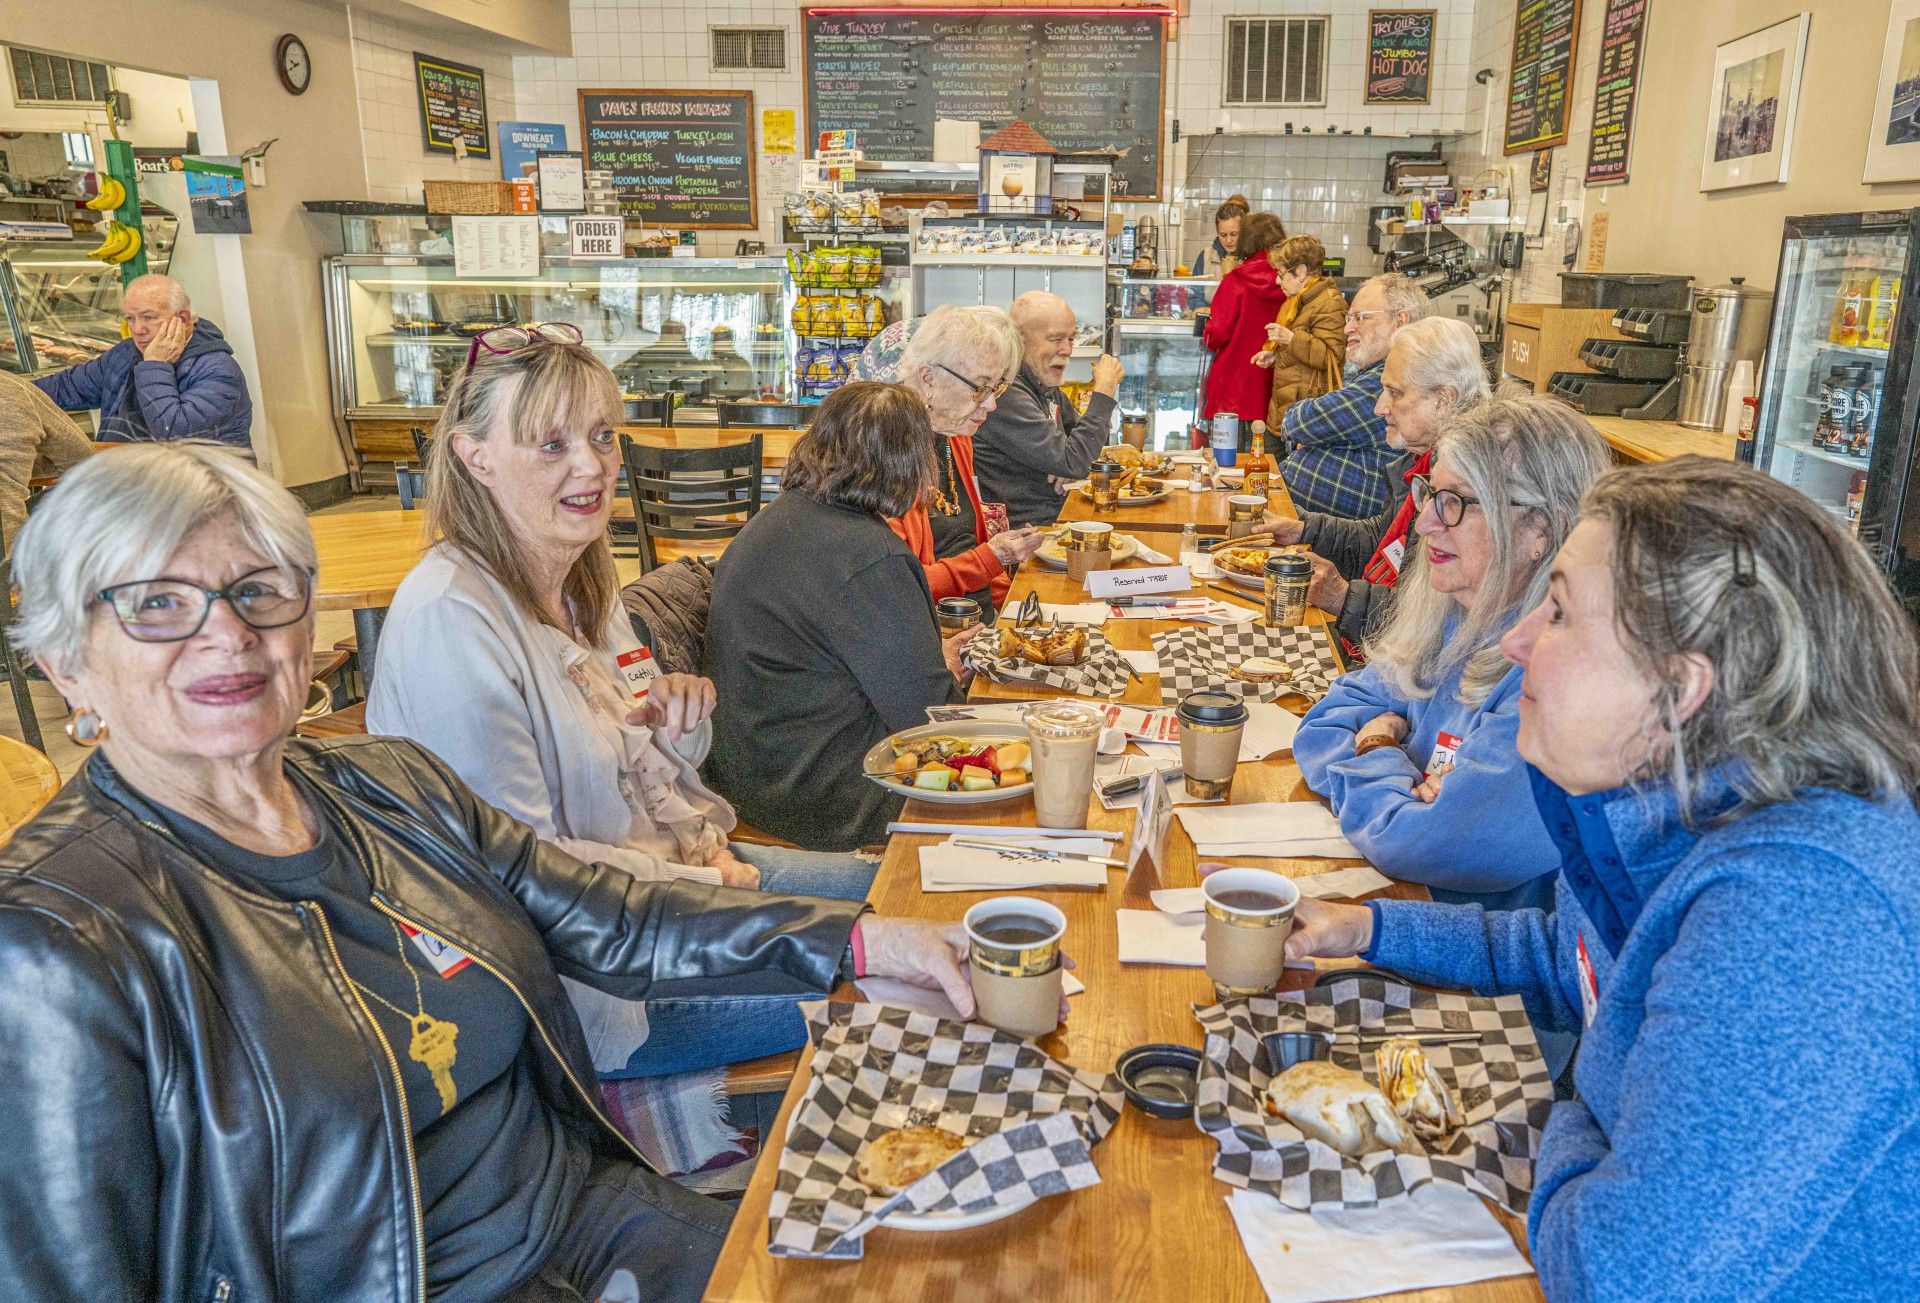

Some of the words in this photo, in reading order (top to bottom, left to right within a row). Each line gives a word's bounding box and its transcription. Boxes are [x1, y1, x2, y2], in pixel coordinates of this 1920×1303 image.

[819, 21, 840, 34] JIVE
[845, 21, 887, 34] TURKEY
[933, 22, 972, 34] CHICKEN
[977, 23, 1010, 34] CUTLET
[1044, 22, 1080, 35] SONYA
[1081, 22, 1127, 35] SPECIAL
[1372, 21, 1392, 36] TRY
[1394, 17, 1419, 32] OUR
[817, 42, 850, 52] STUFFED
[853, 42, 884, 52] TURKEY
[933, 42, 973, 52] CHICKEN
[975, 43, 1020, 52] PARMESAN
[1041, 43, 1093, 53] SOUTHERN
[1098, 43, 1119, 53] MAX
[1372, 38, 1396, 47] BLACK
[1402, 38, 1429, 47] ANGUS
[1381, 48, 1416, 57] JUMBO
[816, 61, 847, 71] DARTH
[849, 61, 881, 71] VADER
[932, 62, 977, 72] EGGPLANT
[979, 62, 1024, 72] PARMESAN
[1041, 62, 1090, 72] BULLSEYE
[1372, 58, 1400, 75] HOT
[1402, 58, 1428, 76] DOG
[816, 81, 833, 90] THE
[835, 81, 860, 90] CLUB
[932, 81, 976, 90] MEATBALL
[977, 81, 1016, 90] GRINDER
[1040, 81, 1071, 92] PHILLY
[1074, 81, 1109, 92] CHEESE
[641, 101, 683, 116] FAMOUS
[684, 102, 732, 117] BURGERS
[816, 101, 846, 109] TURKEY
[847, 101, 878, 109] REUBEN
[935, 101, 968, 110] ITALIAN
[968, 102, 1008, 110] GRINDER
[851, 121, 870, 129] OWN
[1038, 119, 1067, 130] STEAK
[1069, 121, 1088, 130] TIPS
[512, 132, 554, 144] DOWNEAST
[592, 128, 622, 141] BACON
[623, 129, 630, 140] &
[629, 129, 669, 140] CHEDDAR
[673, 129, 710, 141] TURKEY
[711, 132, 734, 140] LOSH
[1076, 140, 1105, 148] VEGGIE
[593, 151, 616, 162] BLUE
[619, 151, 654, 162] CHEESE
[674, 152, 705, 164] VEGGIE
[706, 155, 742, 165] BURGER
[134, 157, 170, 172] Boar's
[647, 175, 673, 185] ONION
[675, 174, 718, 186] PORTABELLA
[679, 186, 720, 195] SUPREME
[664, 193, 691, 201] ORDERS
[633, 201, 657, 210] FRIES
[670, 202, 697, 210] SWEET
[699, 203, 729, 211] POTATO
[728, 202, 749, 211] FRIES
[575, 222, 617, 237] ORDER
[581, 239, 613, 253] HERE
[1511, 339, 1530, 365] PUSH
[1112, 576, 1146, 587] Reserved
[627, 668, 656, 682] Cathy
